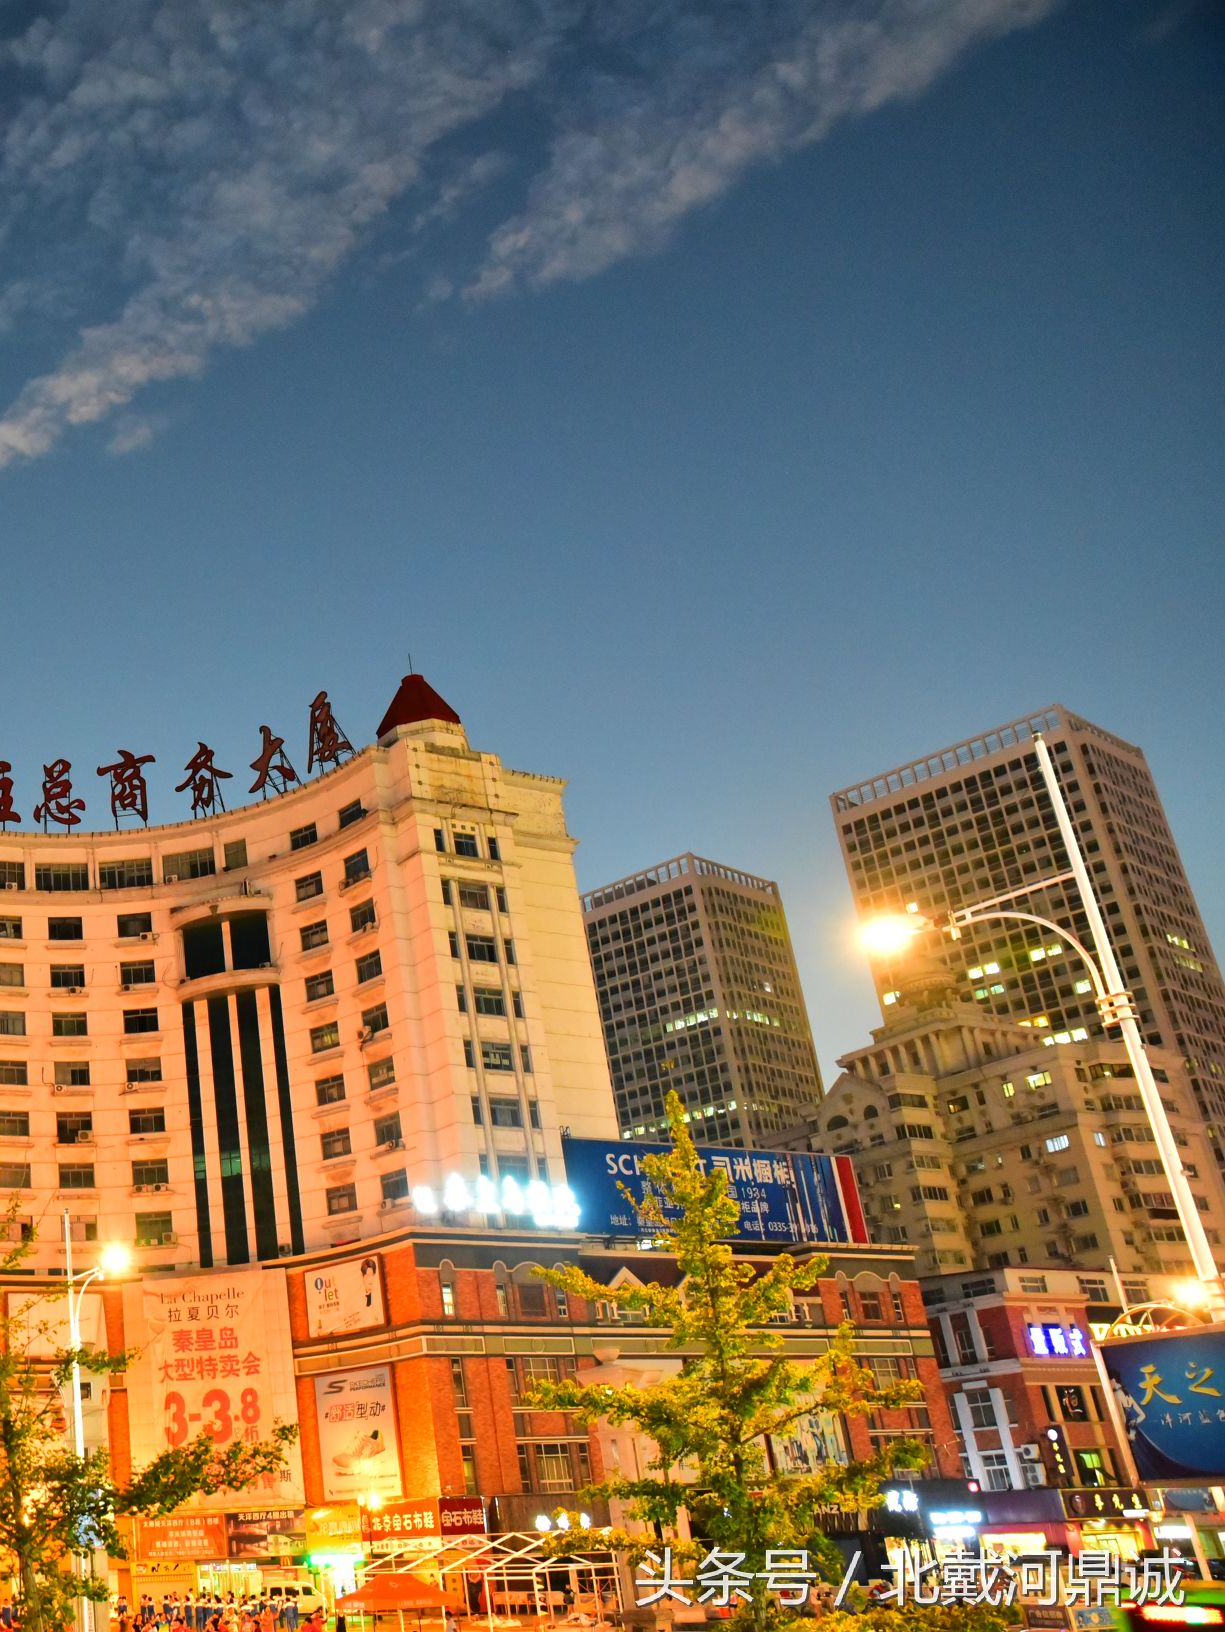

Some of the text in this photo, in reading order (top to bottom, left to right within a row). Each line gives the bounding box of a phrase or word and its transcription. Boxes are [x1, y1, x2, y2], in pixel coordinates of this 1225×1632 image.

[605, 1153, 706, 1180] SCHT
[182, 1287, 245, 1304] Chapelle
[168, 1303, 241, 1323] 拉夏贝尔
[172, 1326, 239, 1353] 秦皇岛
[158, 1351, 262, 1384] 大型特卖会
